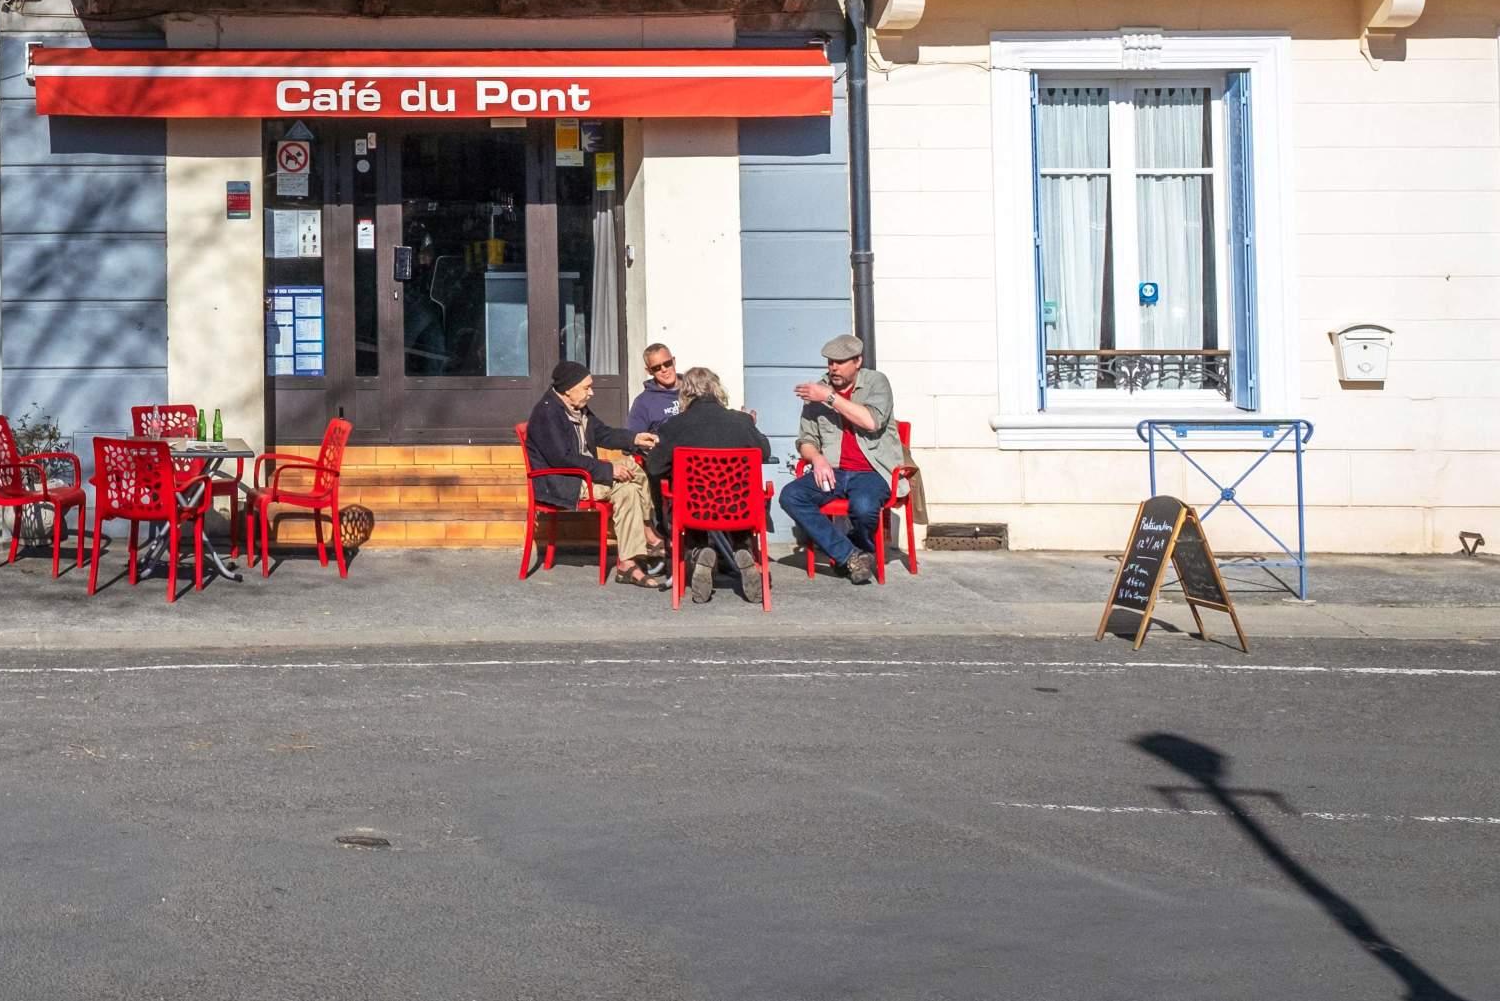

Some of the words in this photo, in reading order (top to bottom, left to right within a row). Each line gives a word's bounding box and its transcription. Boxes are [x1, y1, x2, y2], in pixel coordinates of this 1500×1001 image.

[275, 80, 382, 113] Café
[401, 81, 457, 112] du
[476, 80, 592, 112] Pont
